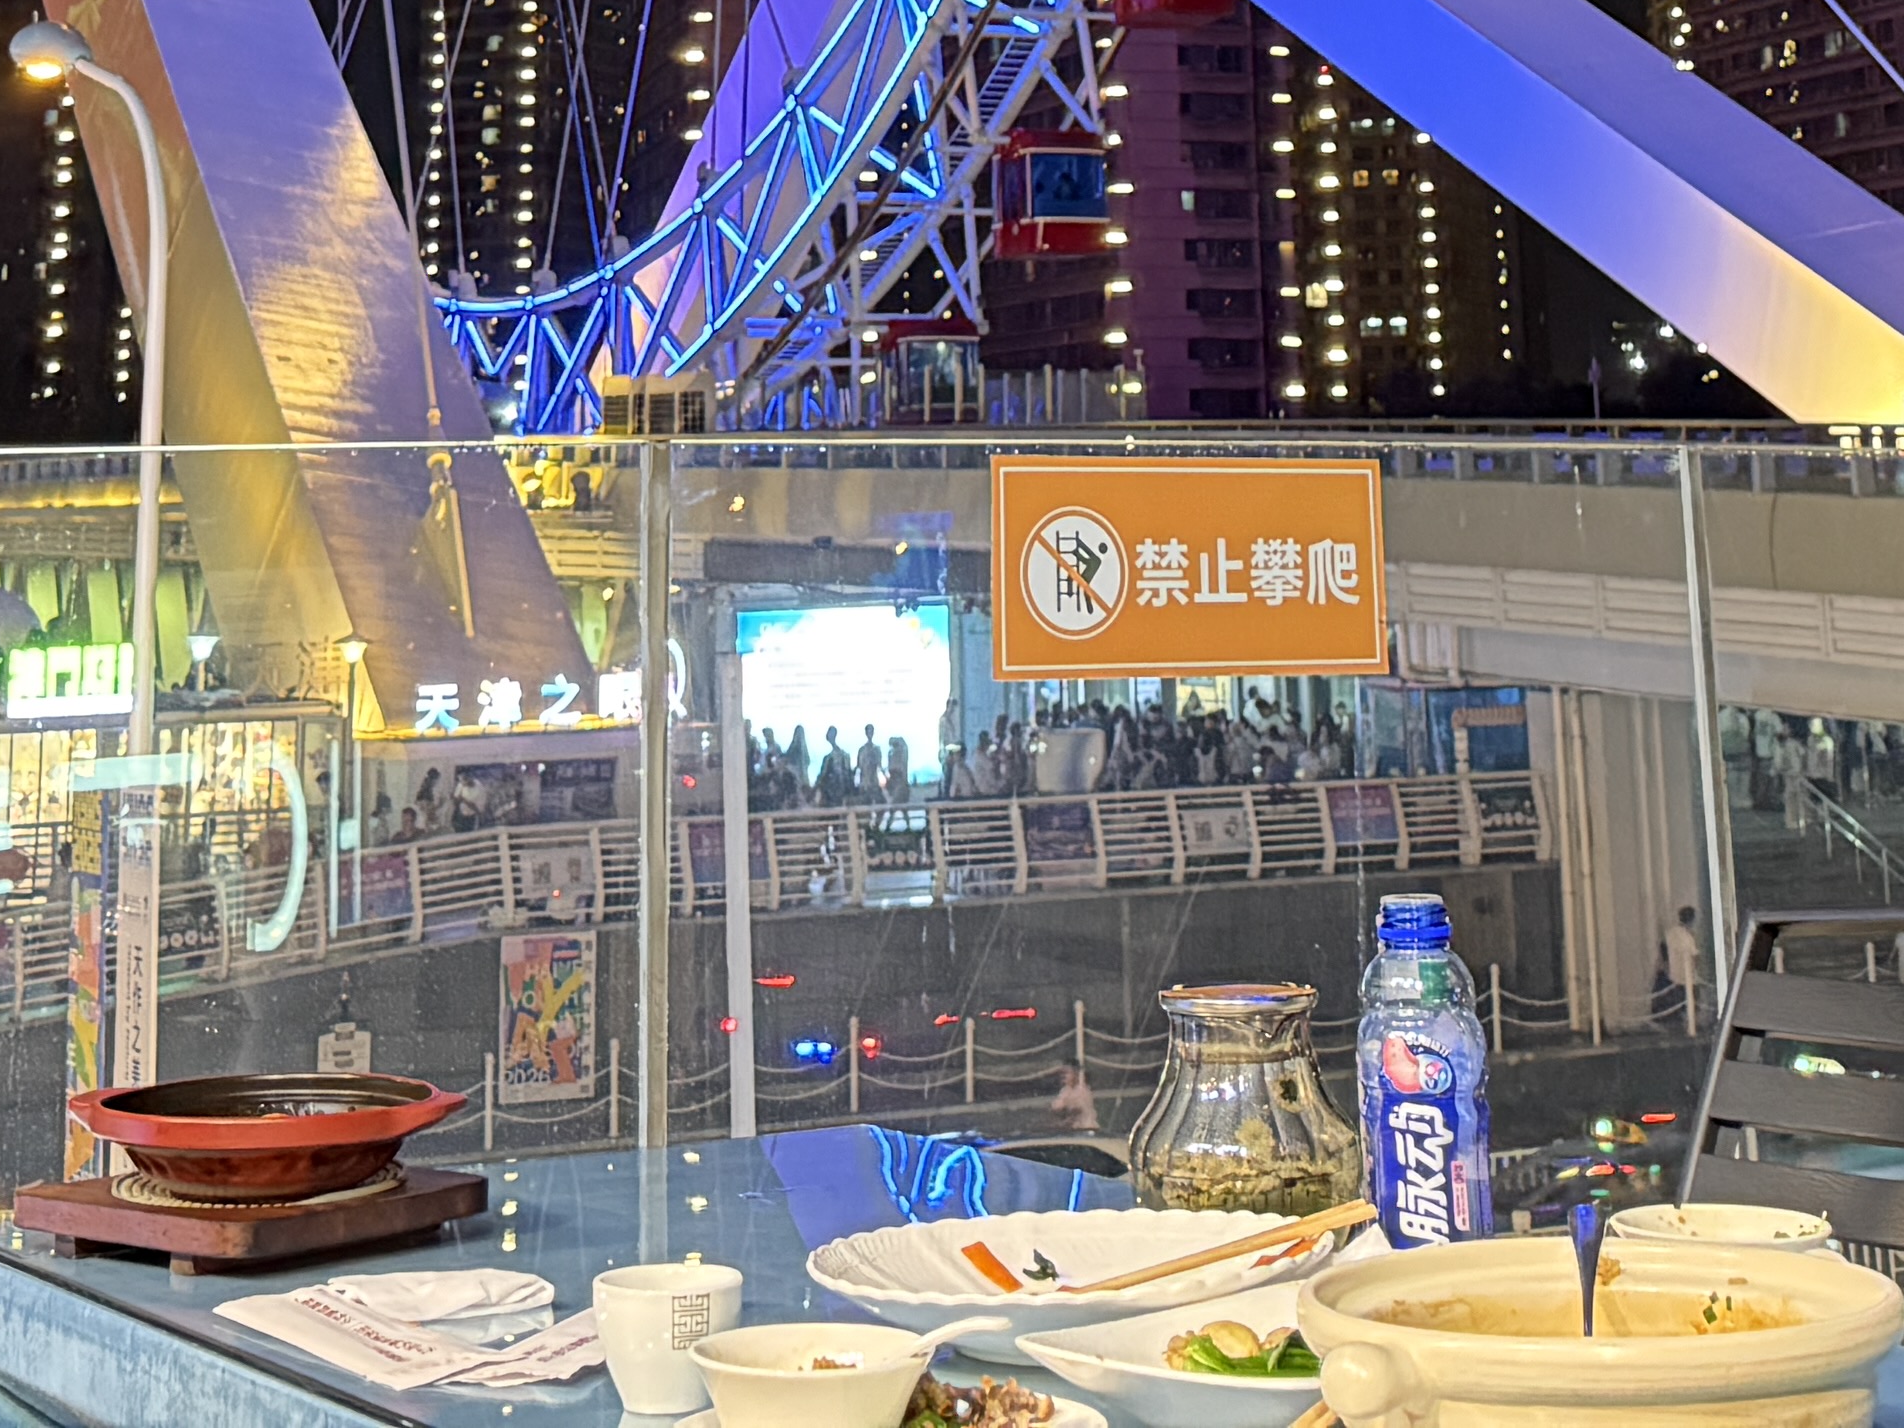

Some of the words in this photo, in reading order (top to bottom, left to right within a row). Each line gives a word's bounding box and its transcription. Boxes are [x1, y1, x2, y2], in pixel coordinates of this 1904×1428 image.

[1134, 537, 1360, 608] 禁止攀爬
[414, 672, 643, 732] 天津之眼
[1389, 1101, 1454, 1246] 脉动
